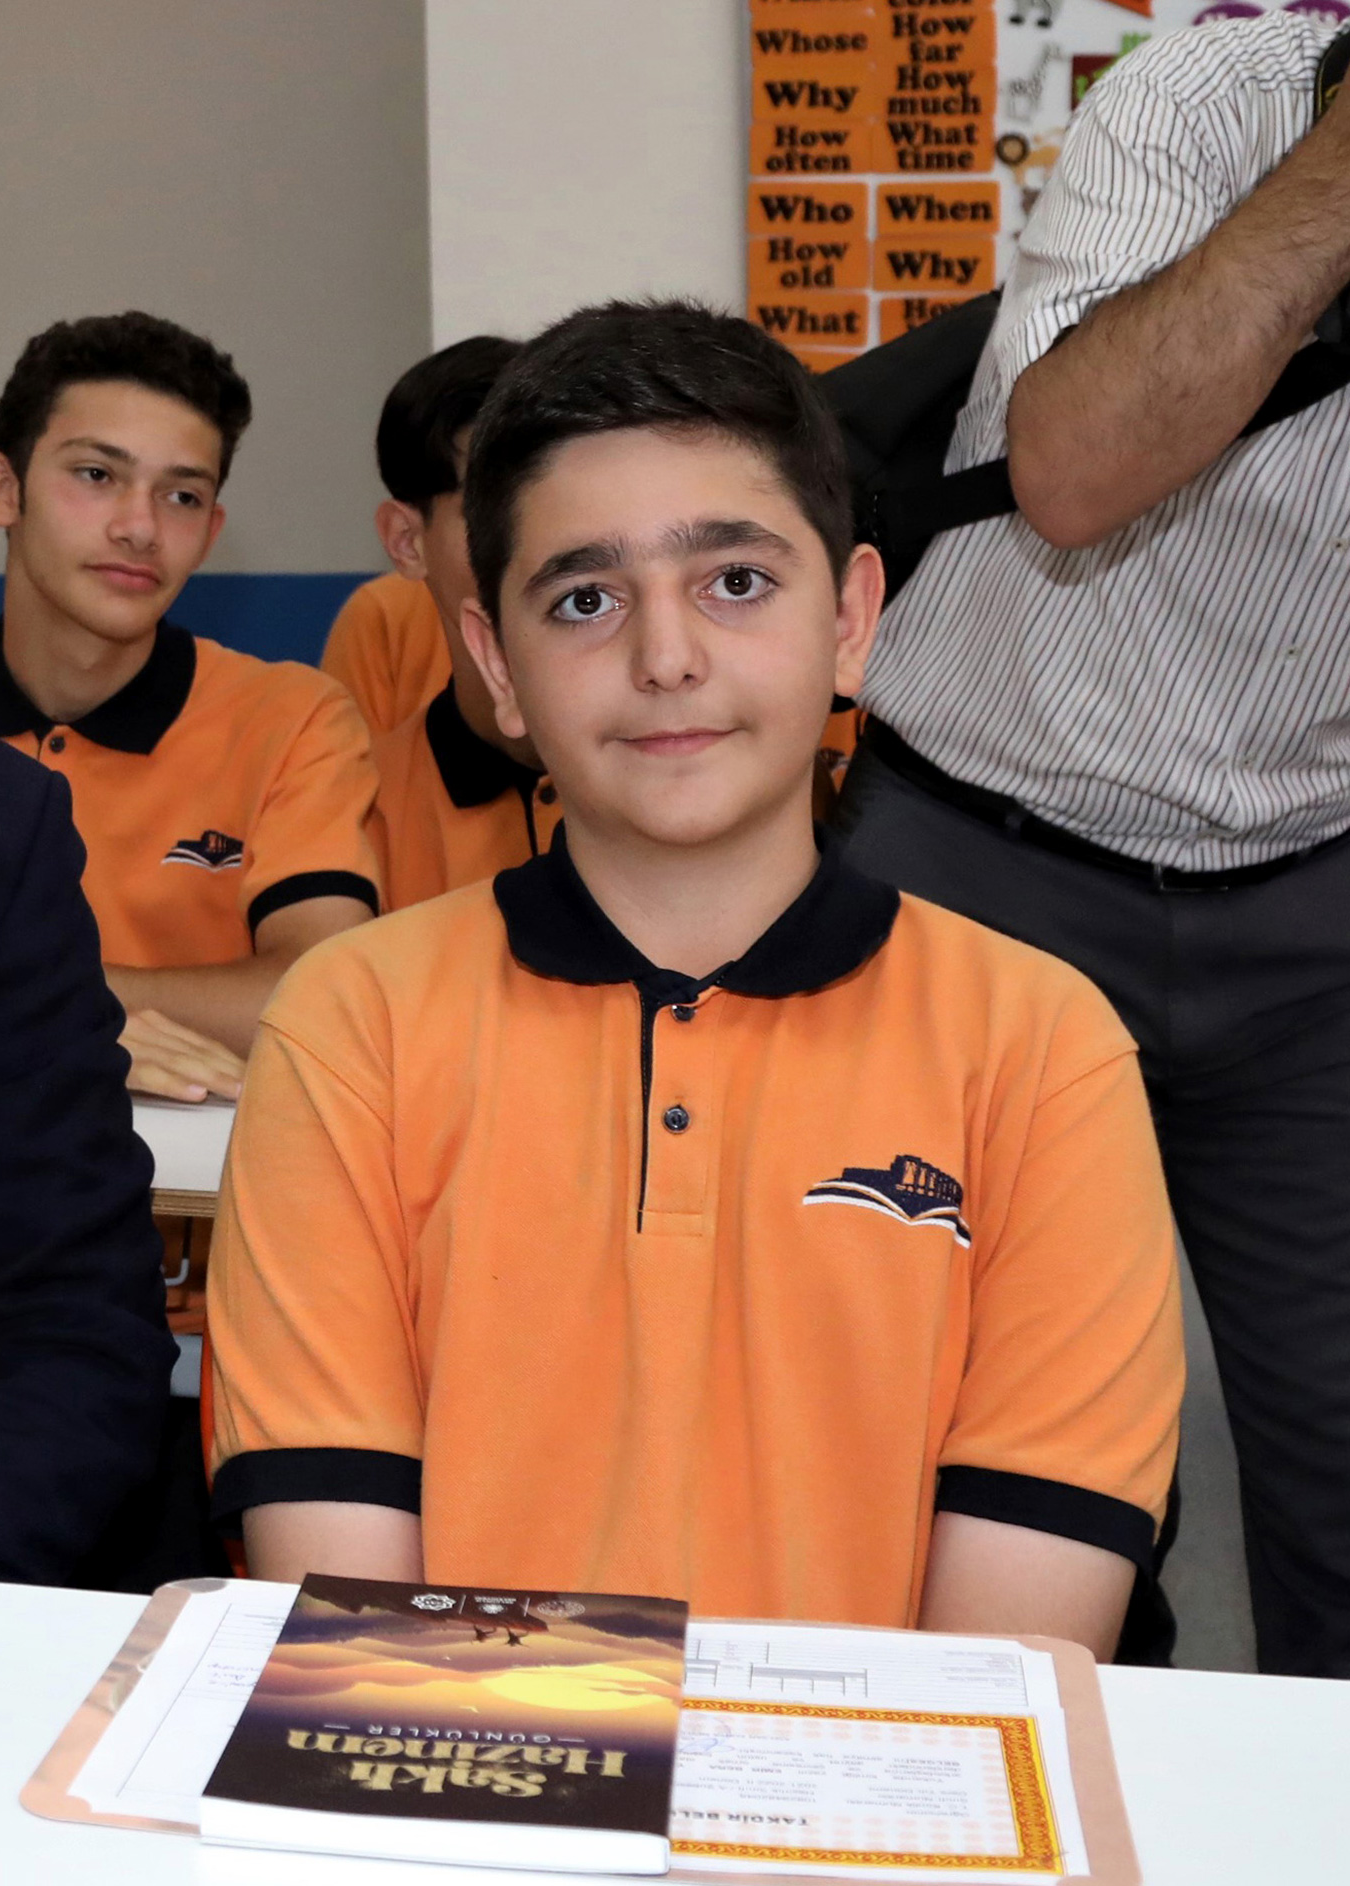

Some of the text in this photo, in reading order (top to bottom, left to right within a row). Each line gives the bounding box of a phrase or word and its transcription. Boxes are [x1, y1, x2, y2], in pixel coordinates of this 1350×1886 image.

[892, 13, 975, 39] How
[756, 29, 868, 54] Whose
[909, 41, 963, 62] far
[896, 65, 975, 92] How
[764, 80, 858, 112] Why
[887, 93, 981, 116] much
[775, 125, 848, 148] How
[887, 120, 977, 146] What
[765, 152, 850, 173] often
[897, 147, 973, 171] time
[759, 195, 854, 223] Who
[885, 194, 993, 222] When
[768, 238, 849, 262] How
[780, 264, 833, 288] old
[887, 250, 980, 285] Why
[758, 305, 859, 335] What
[903, 297, 964, 321] Ho
[368, 1724, 551, 1744] GÜNLÜKLER
[288, 1728, 627, 1777] Hazinem
[351, 1760, 547, 1797] Saklı
